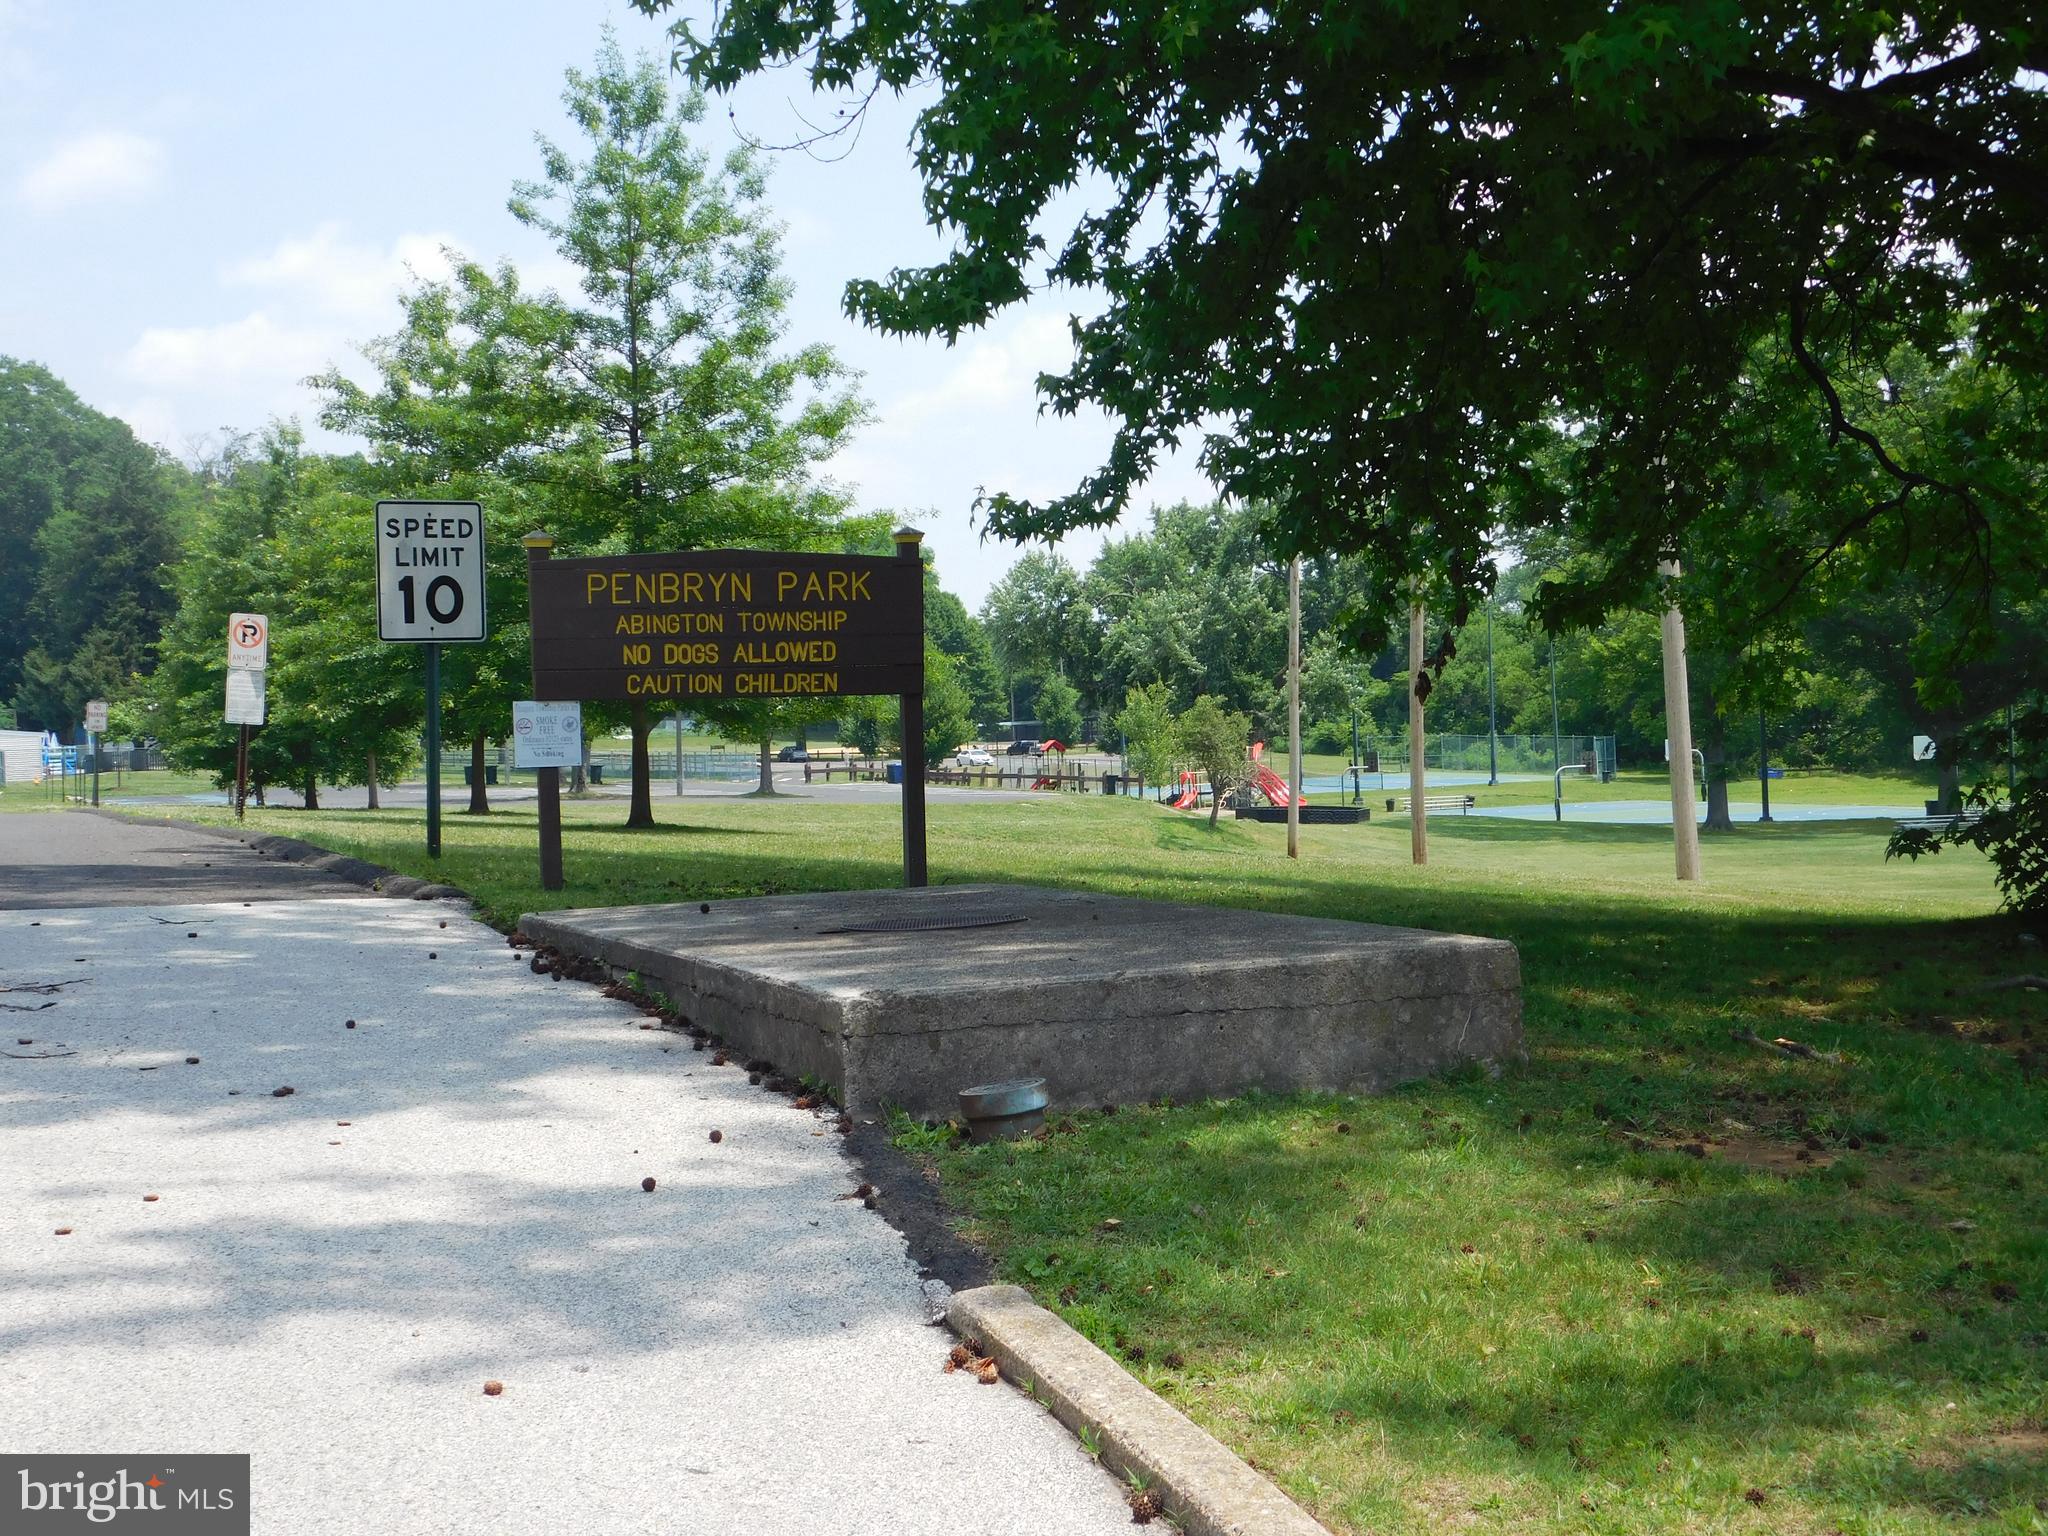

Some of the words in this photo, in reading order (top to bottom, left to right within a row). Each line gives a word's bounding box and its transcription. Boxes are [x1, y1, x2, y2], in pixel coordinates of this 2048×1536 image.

[385, 517, 473, 539] SPEED
[395, 546, 465, 567] LIMIT
[587, 572, 752, 604] PENBRYN
[777, 570, 871, 602] PARK
[398, 574, 464, 624] 10
[615, 613, 724, 635] ABINGTON
[736, 610, 848, 633] TOWNSHIP
[232, 654, 262, 662] ANYTIME
[622, 643, 651, 665] NO
[663, 642, 719, 665] DOGS
[732, 640, 837, 663] ALLOWED
[626, 674, 723, 694] CAUTION
[735, 672, 838, 694] CHILDREN
[539, 725, 555, 735] FREE
